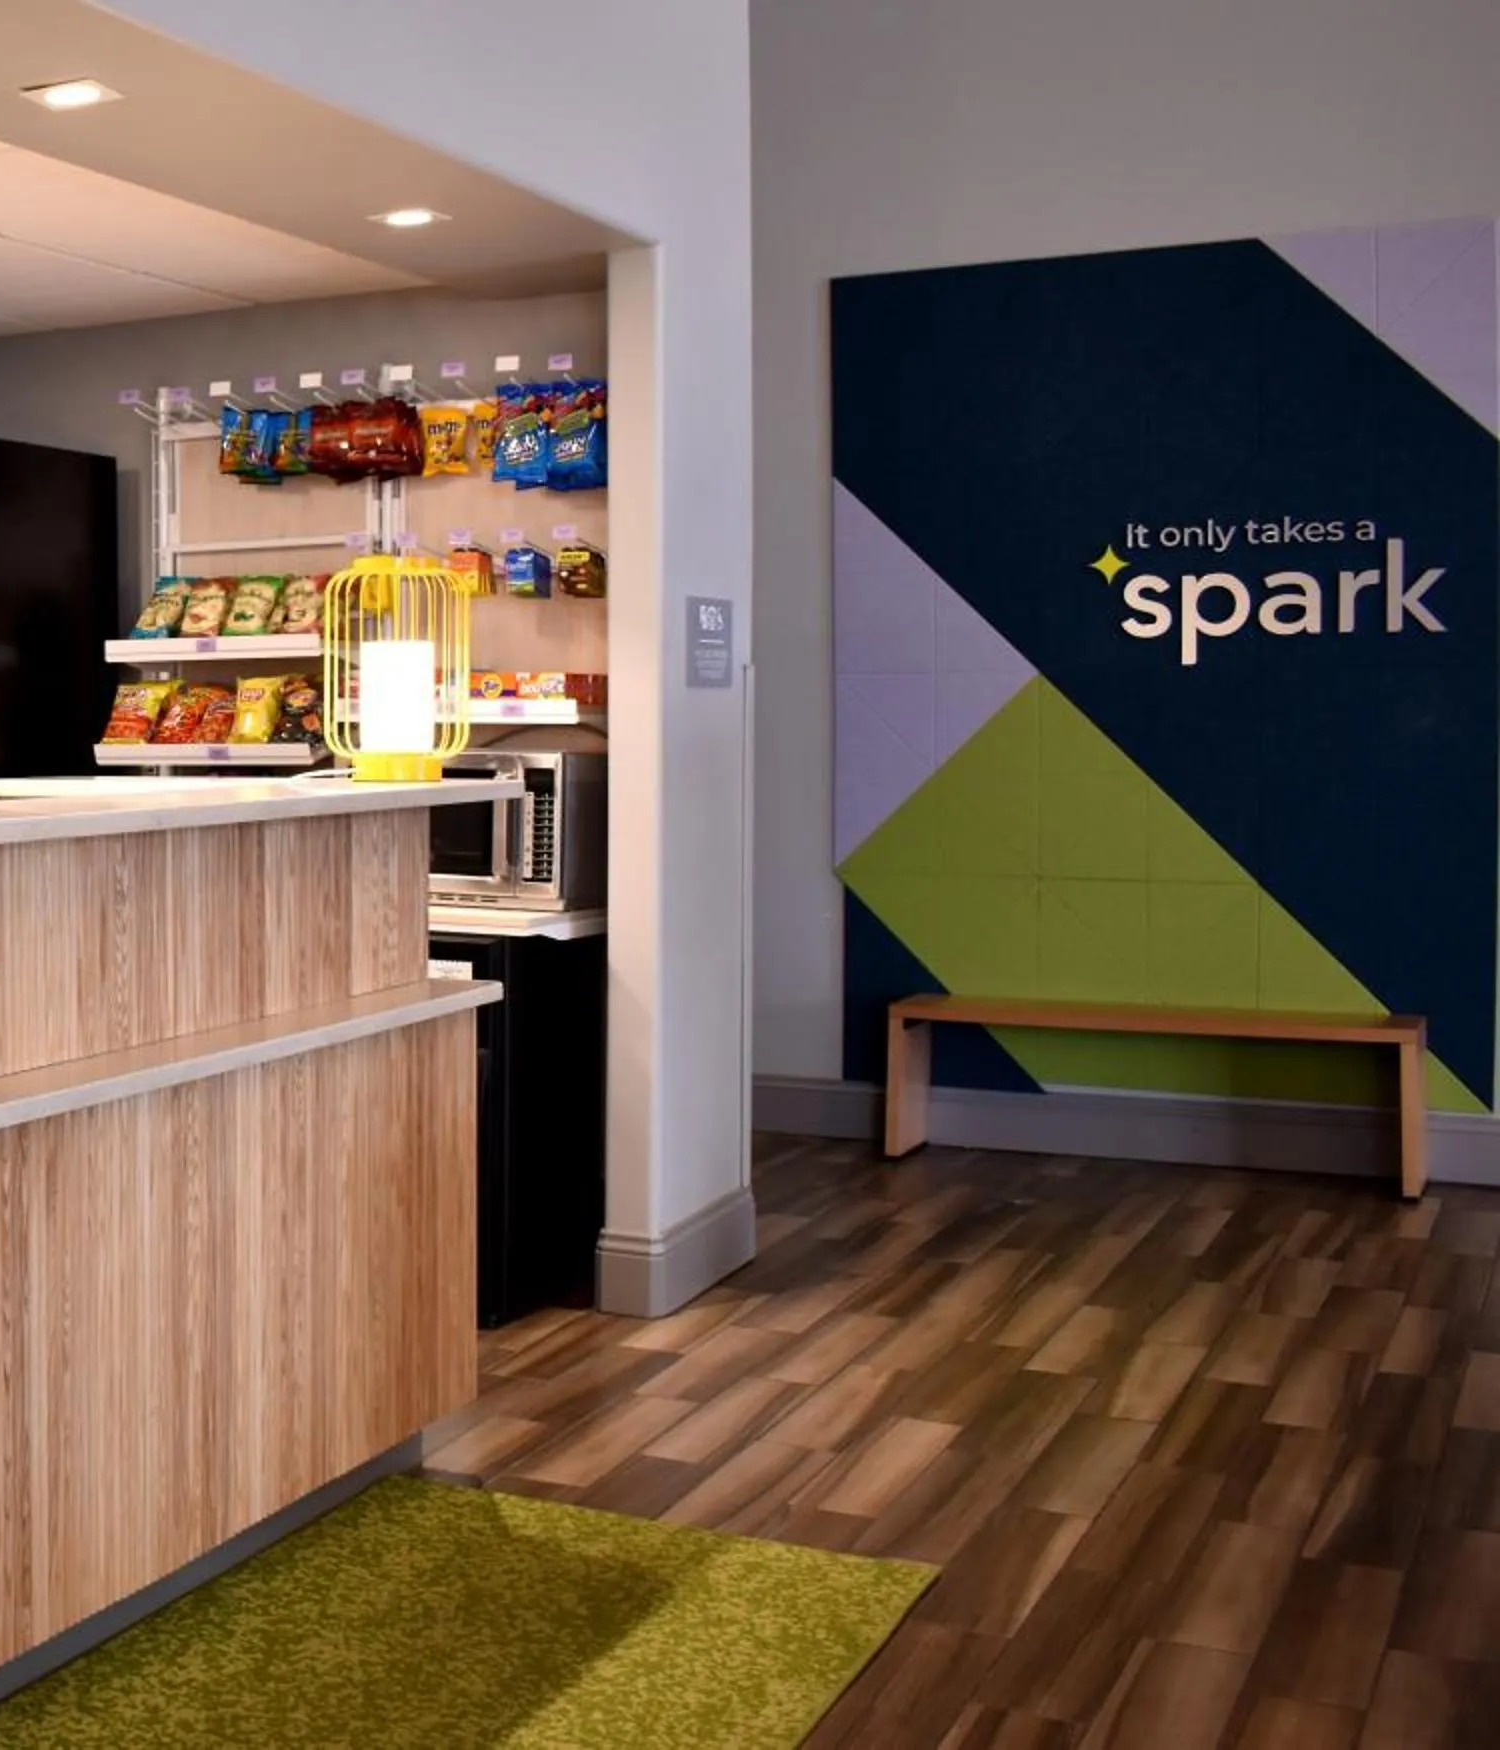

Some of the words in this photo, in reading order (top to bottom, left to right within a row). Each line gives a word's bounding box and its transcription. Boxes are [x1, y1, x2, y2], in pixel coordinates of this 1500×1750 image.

[1126, 523, 1150, 548] It
[1159, 519, 1236, 553] only
[1244, 516, 1344, 545] takes
[1355, 519, 1376, 541] a
[1121, 538, 1448, 666] spark
